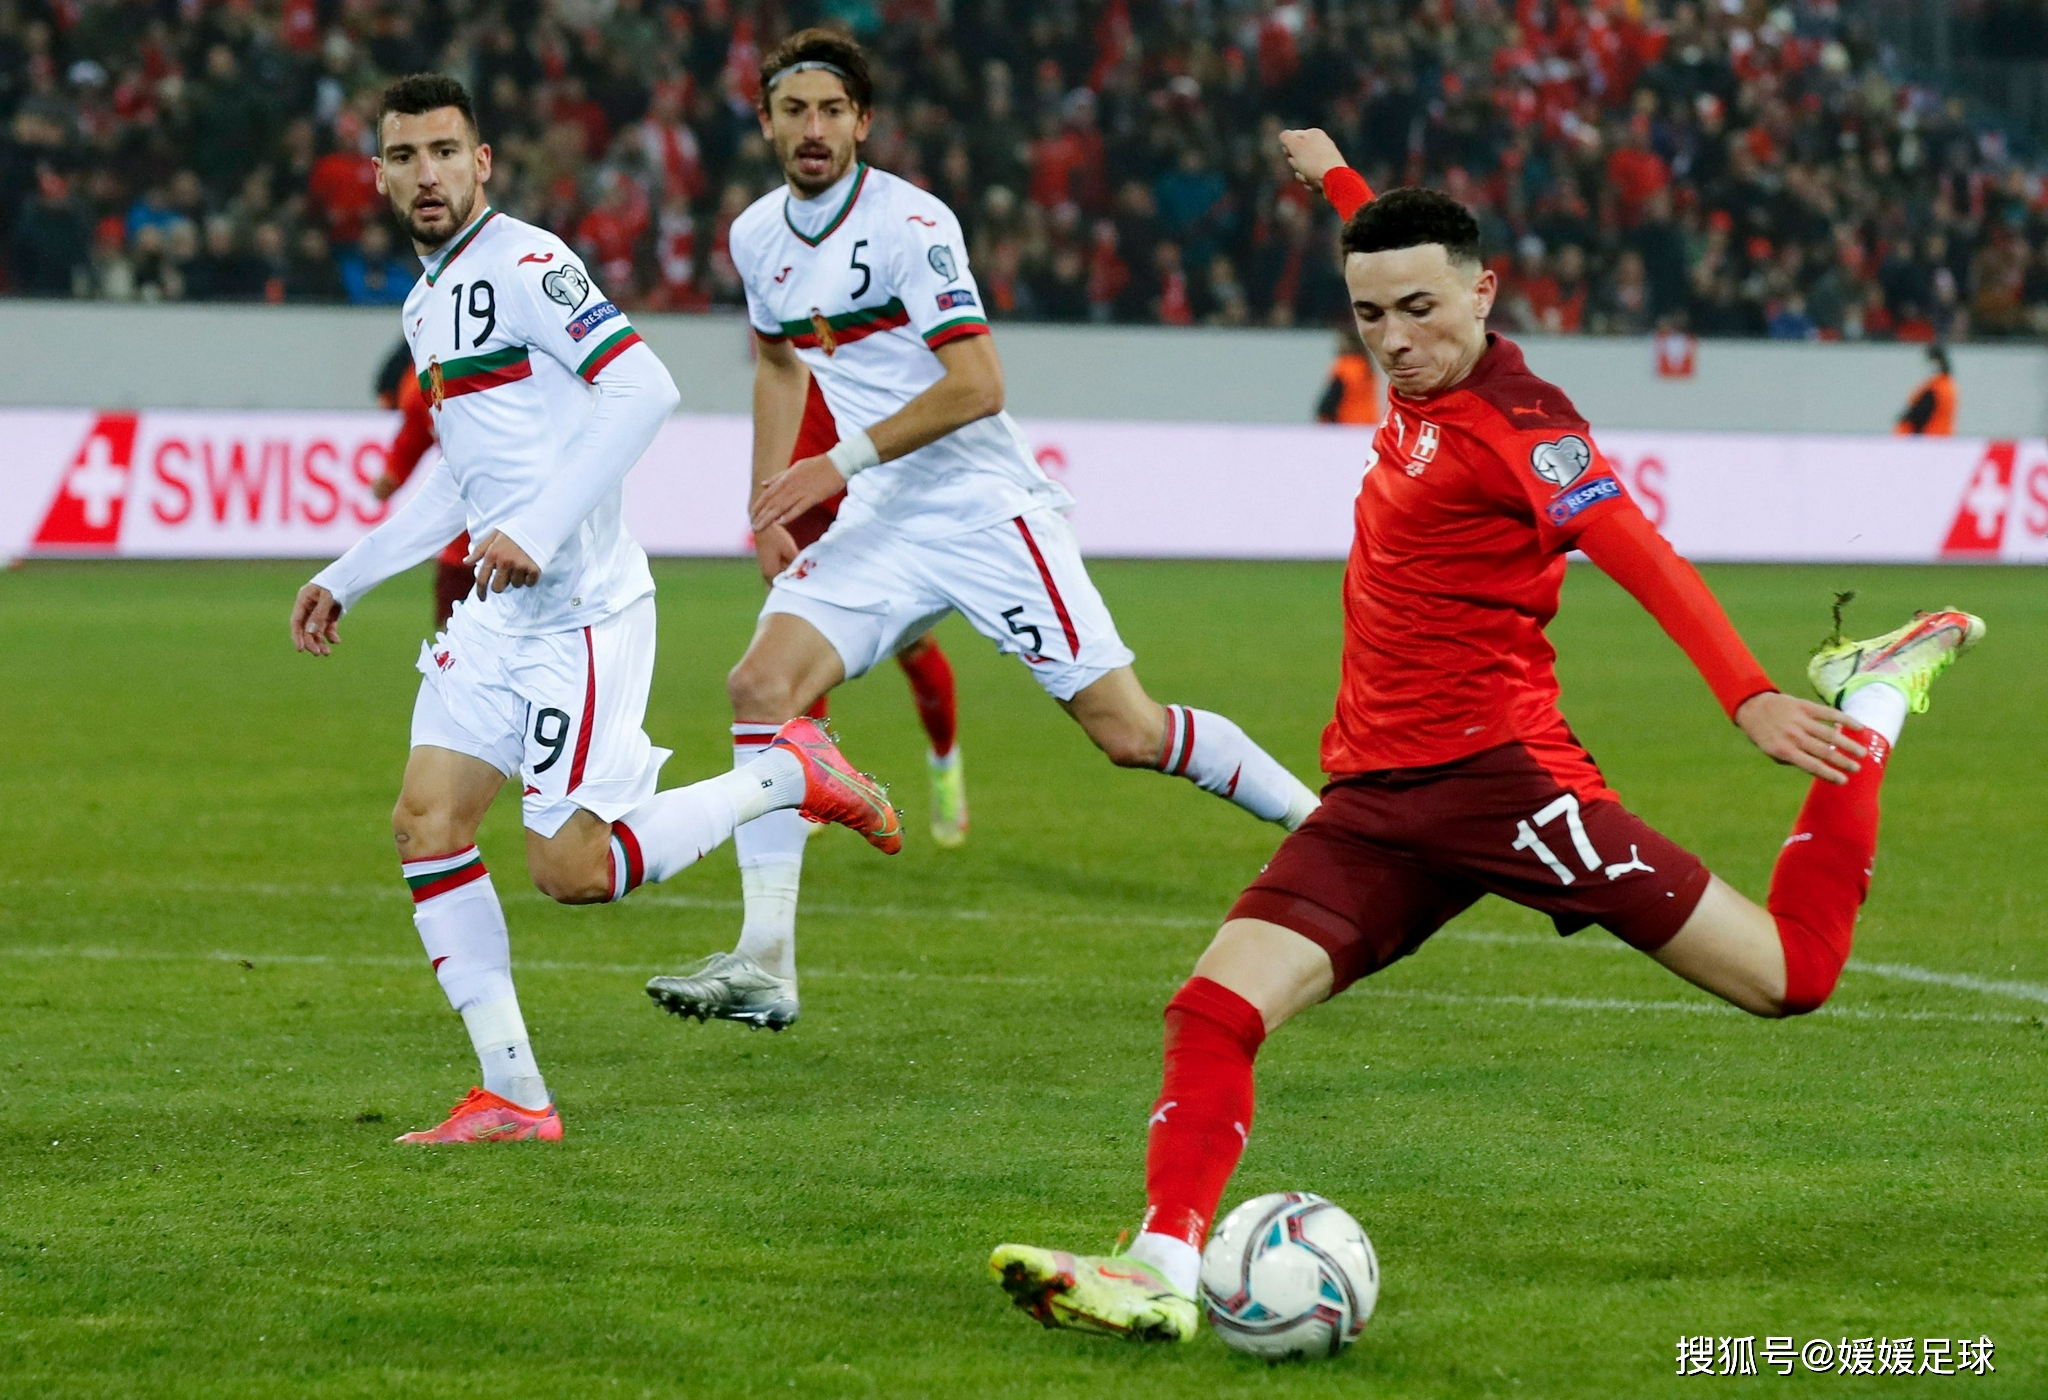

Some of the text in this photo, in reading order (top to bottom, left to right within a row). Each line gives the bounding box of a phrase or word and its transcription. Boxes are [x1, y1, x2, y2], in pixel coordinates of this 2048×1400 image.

[850, 239, 870, 300] 5
[452, 280, 496, 350] 19
[582, 303, 617, 328] RESPECT
[153, 440, 390, 525] SWISS
[1567, 481, 1618, 509] RESPECT
[1001, 605, 1042, 654] 5
[1512, 793, 1603, 886] 17
